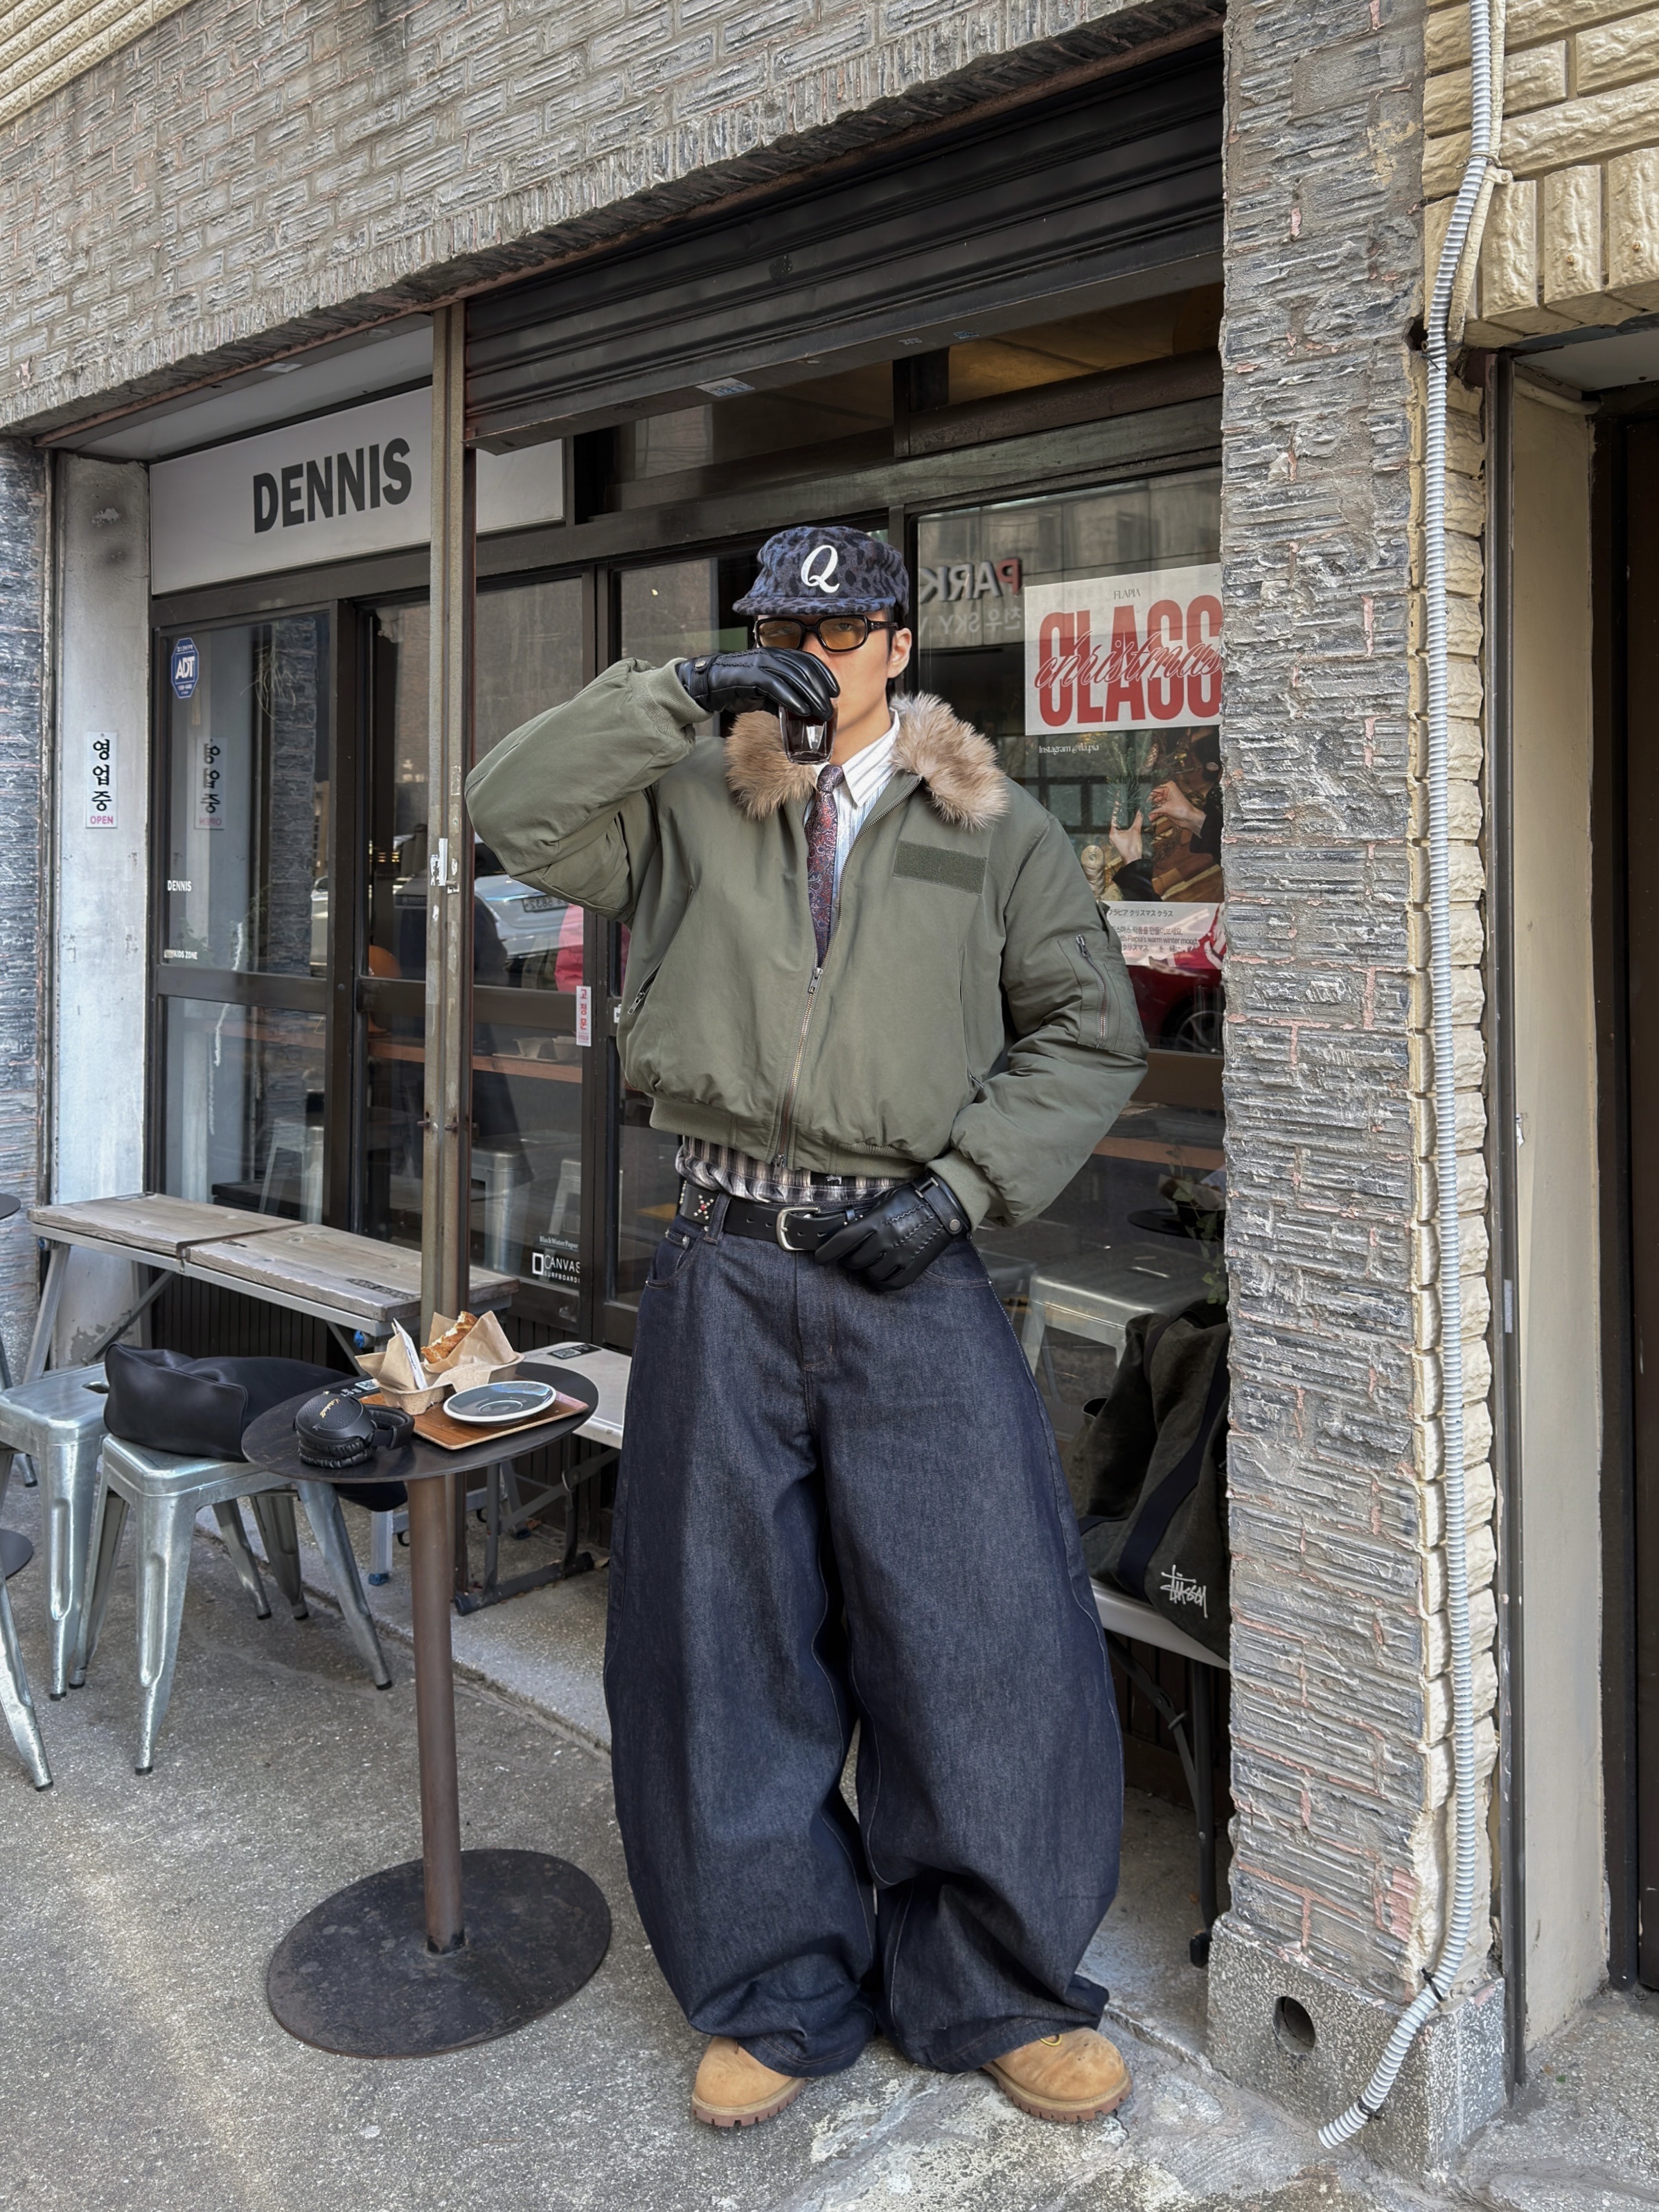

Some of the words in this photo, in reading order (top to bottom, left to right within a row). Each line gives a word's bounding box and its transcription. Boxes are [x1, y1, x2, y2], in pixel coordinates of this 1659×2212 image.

[253, 438, 412, 533] DENNIS
[801, 545, 840, 593] Q
[1114, 588, 1141, 600] FLAPIA
[175, 656, 195, 680] ADT
[1039, 594, 1223, 727] CLASS
[1039, 745, 1071, 755] Instagram
[91, 738, 112, 811] 영업중
[90, 815, 114, 824] OPEN
[167, 880, 192, 892] DENNIS
[185, 951, 198, 959] ZONE
[580, 989, 588, 1030] 고정문
[544, 1255, 580, 1274] CANVAS
